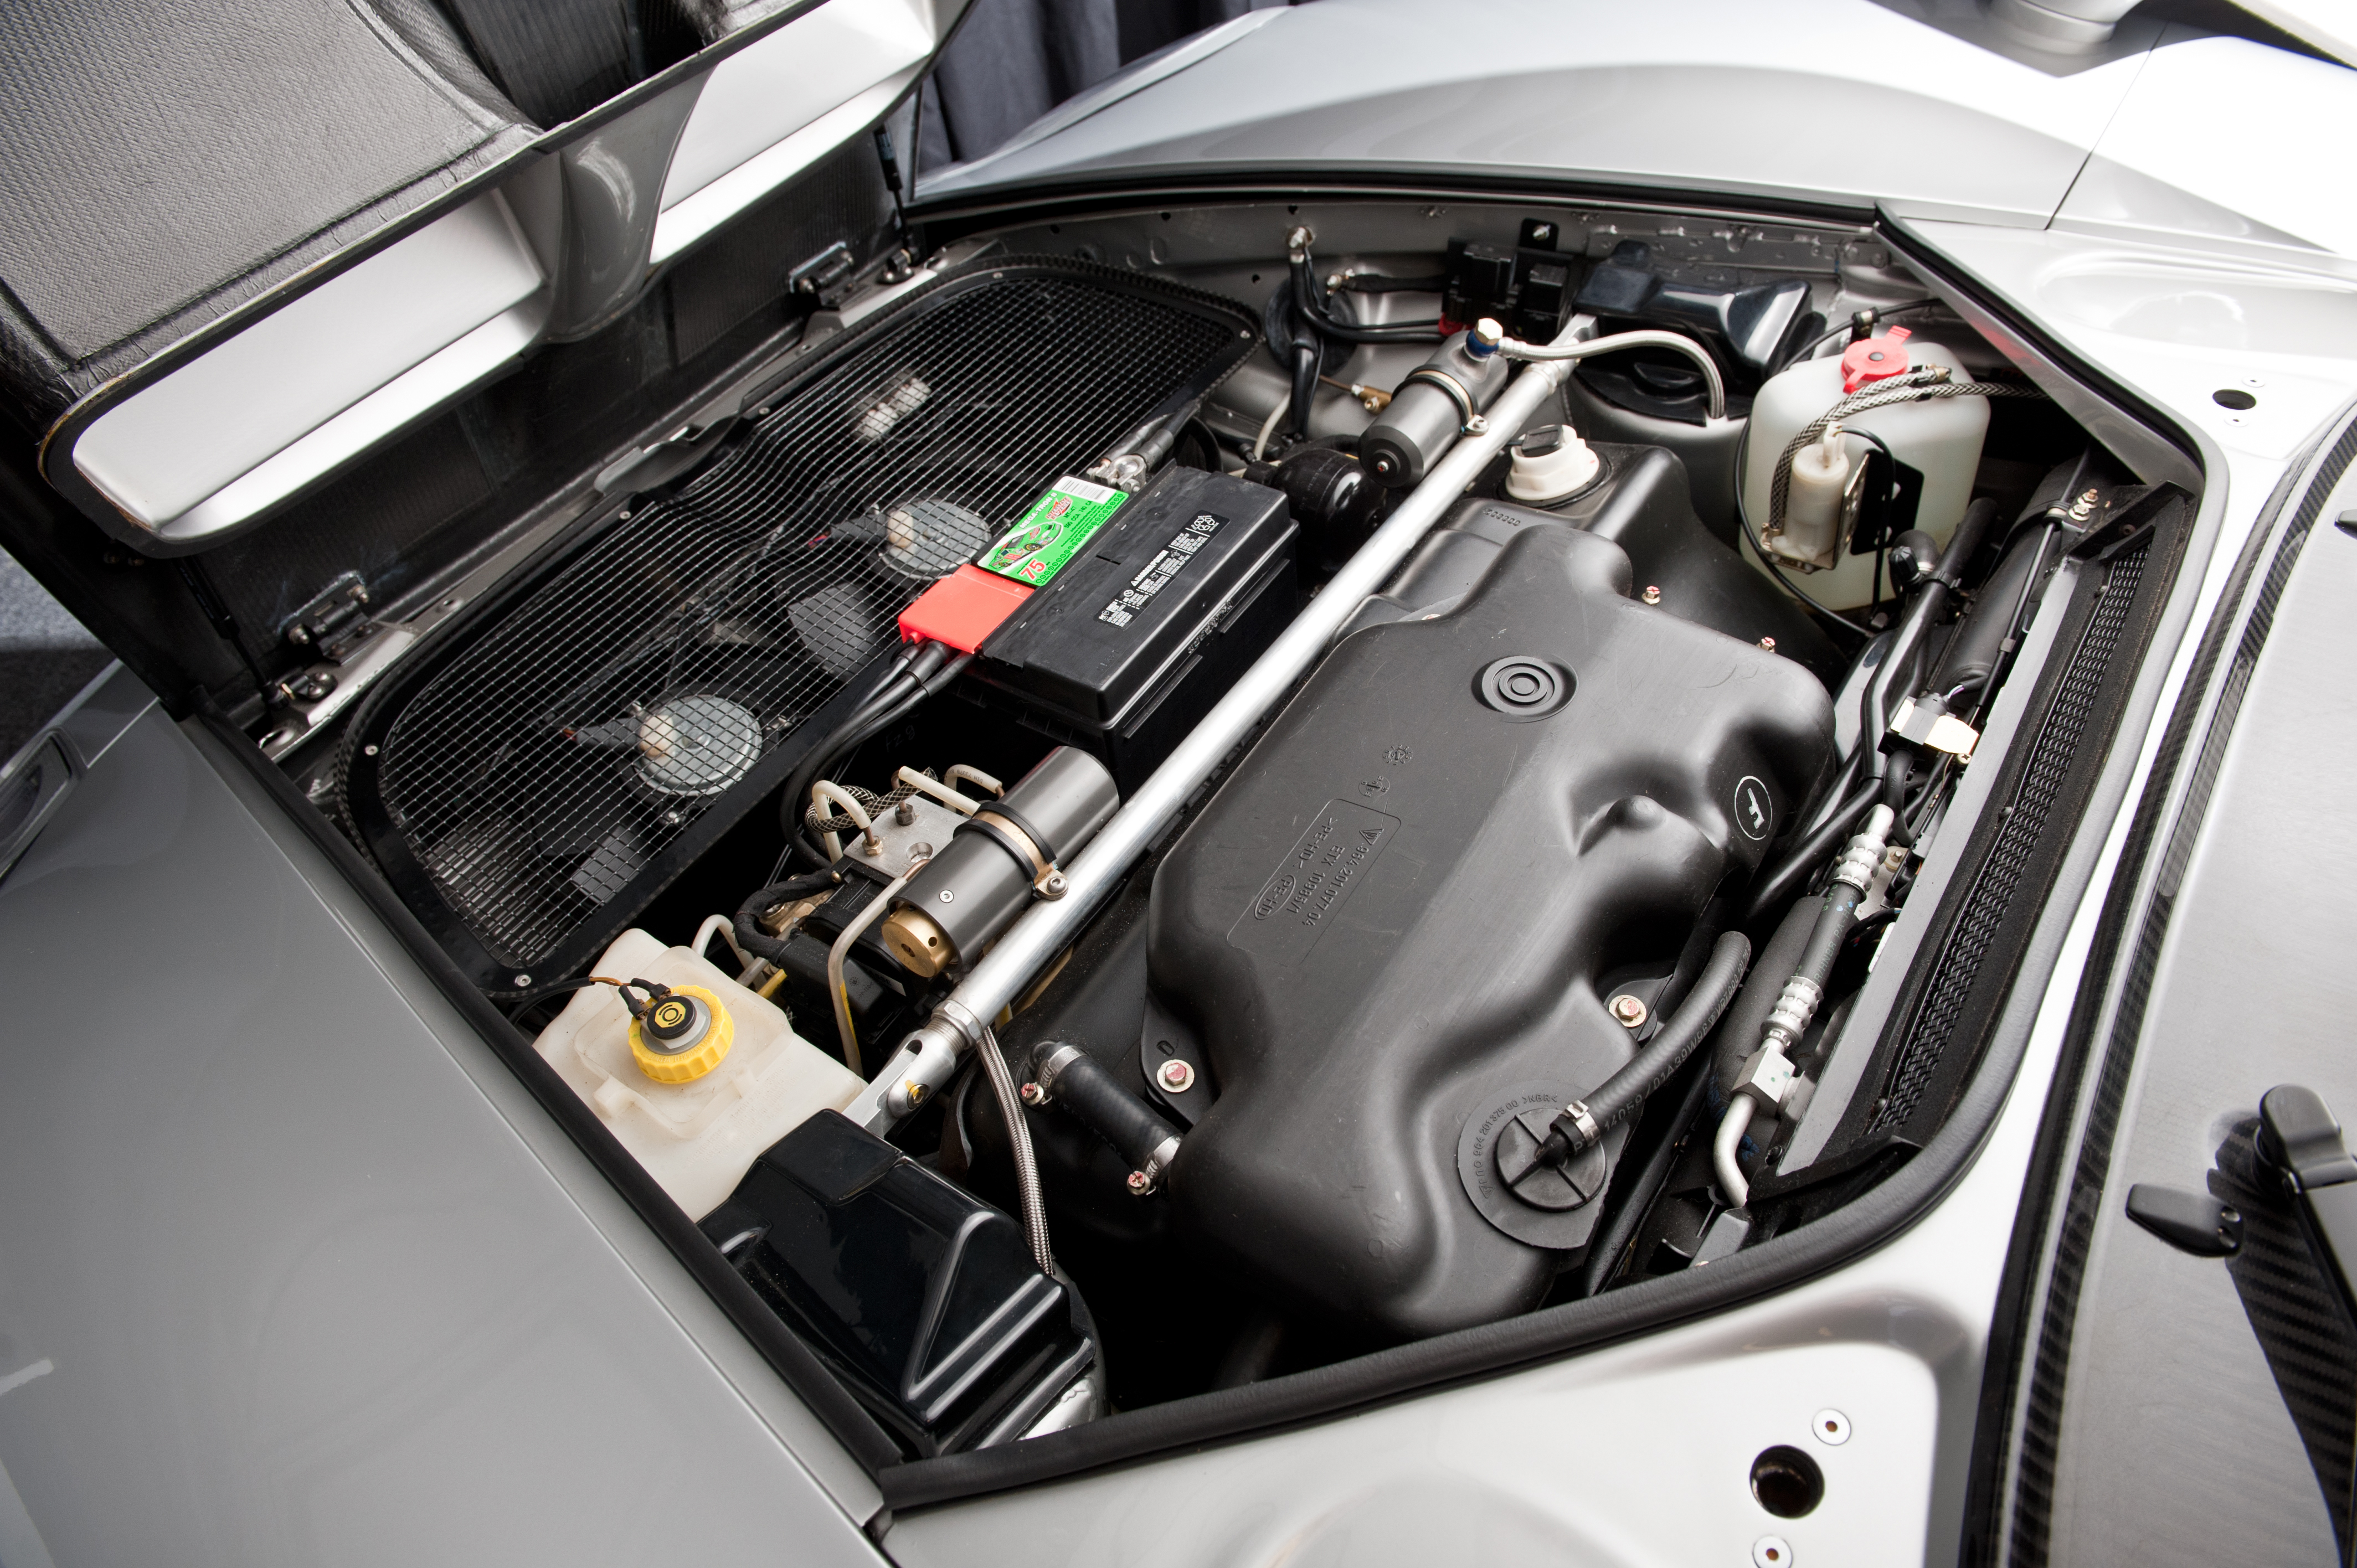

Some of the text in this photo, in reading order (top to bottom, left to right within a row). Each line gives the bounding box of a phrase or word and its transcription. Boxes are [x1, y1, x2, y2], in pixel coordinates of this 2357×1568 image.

[1020, 496, 1053, 528] MEGA-TRON
[1020, 559, 1046, 580] 75
[1480, 1115, 1494, 1135] 201
